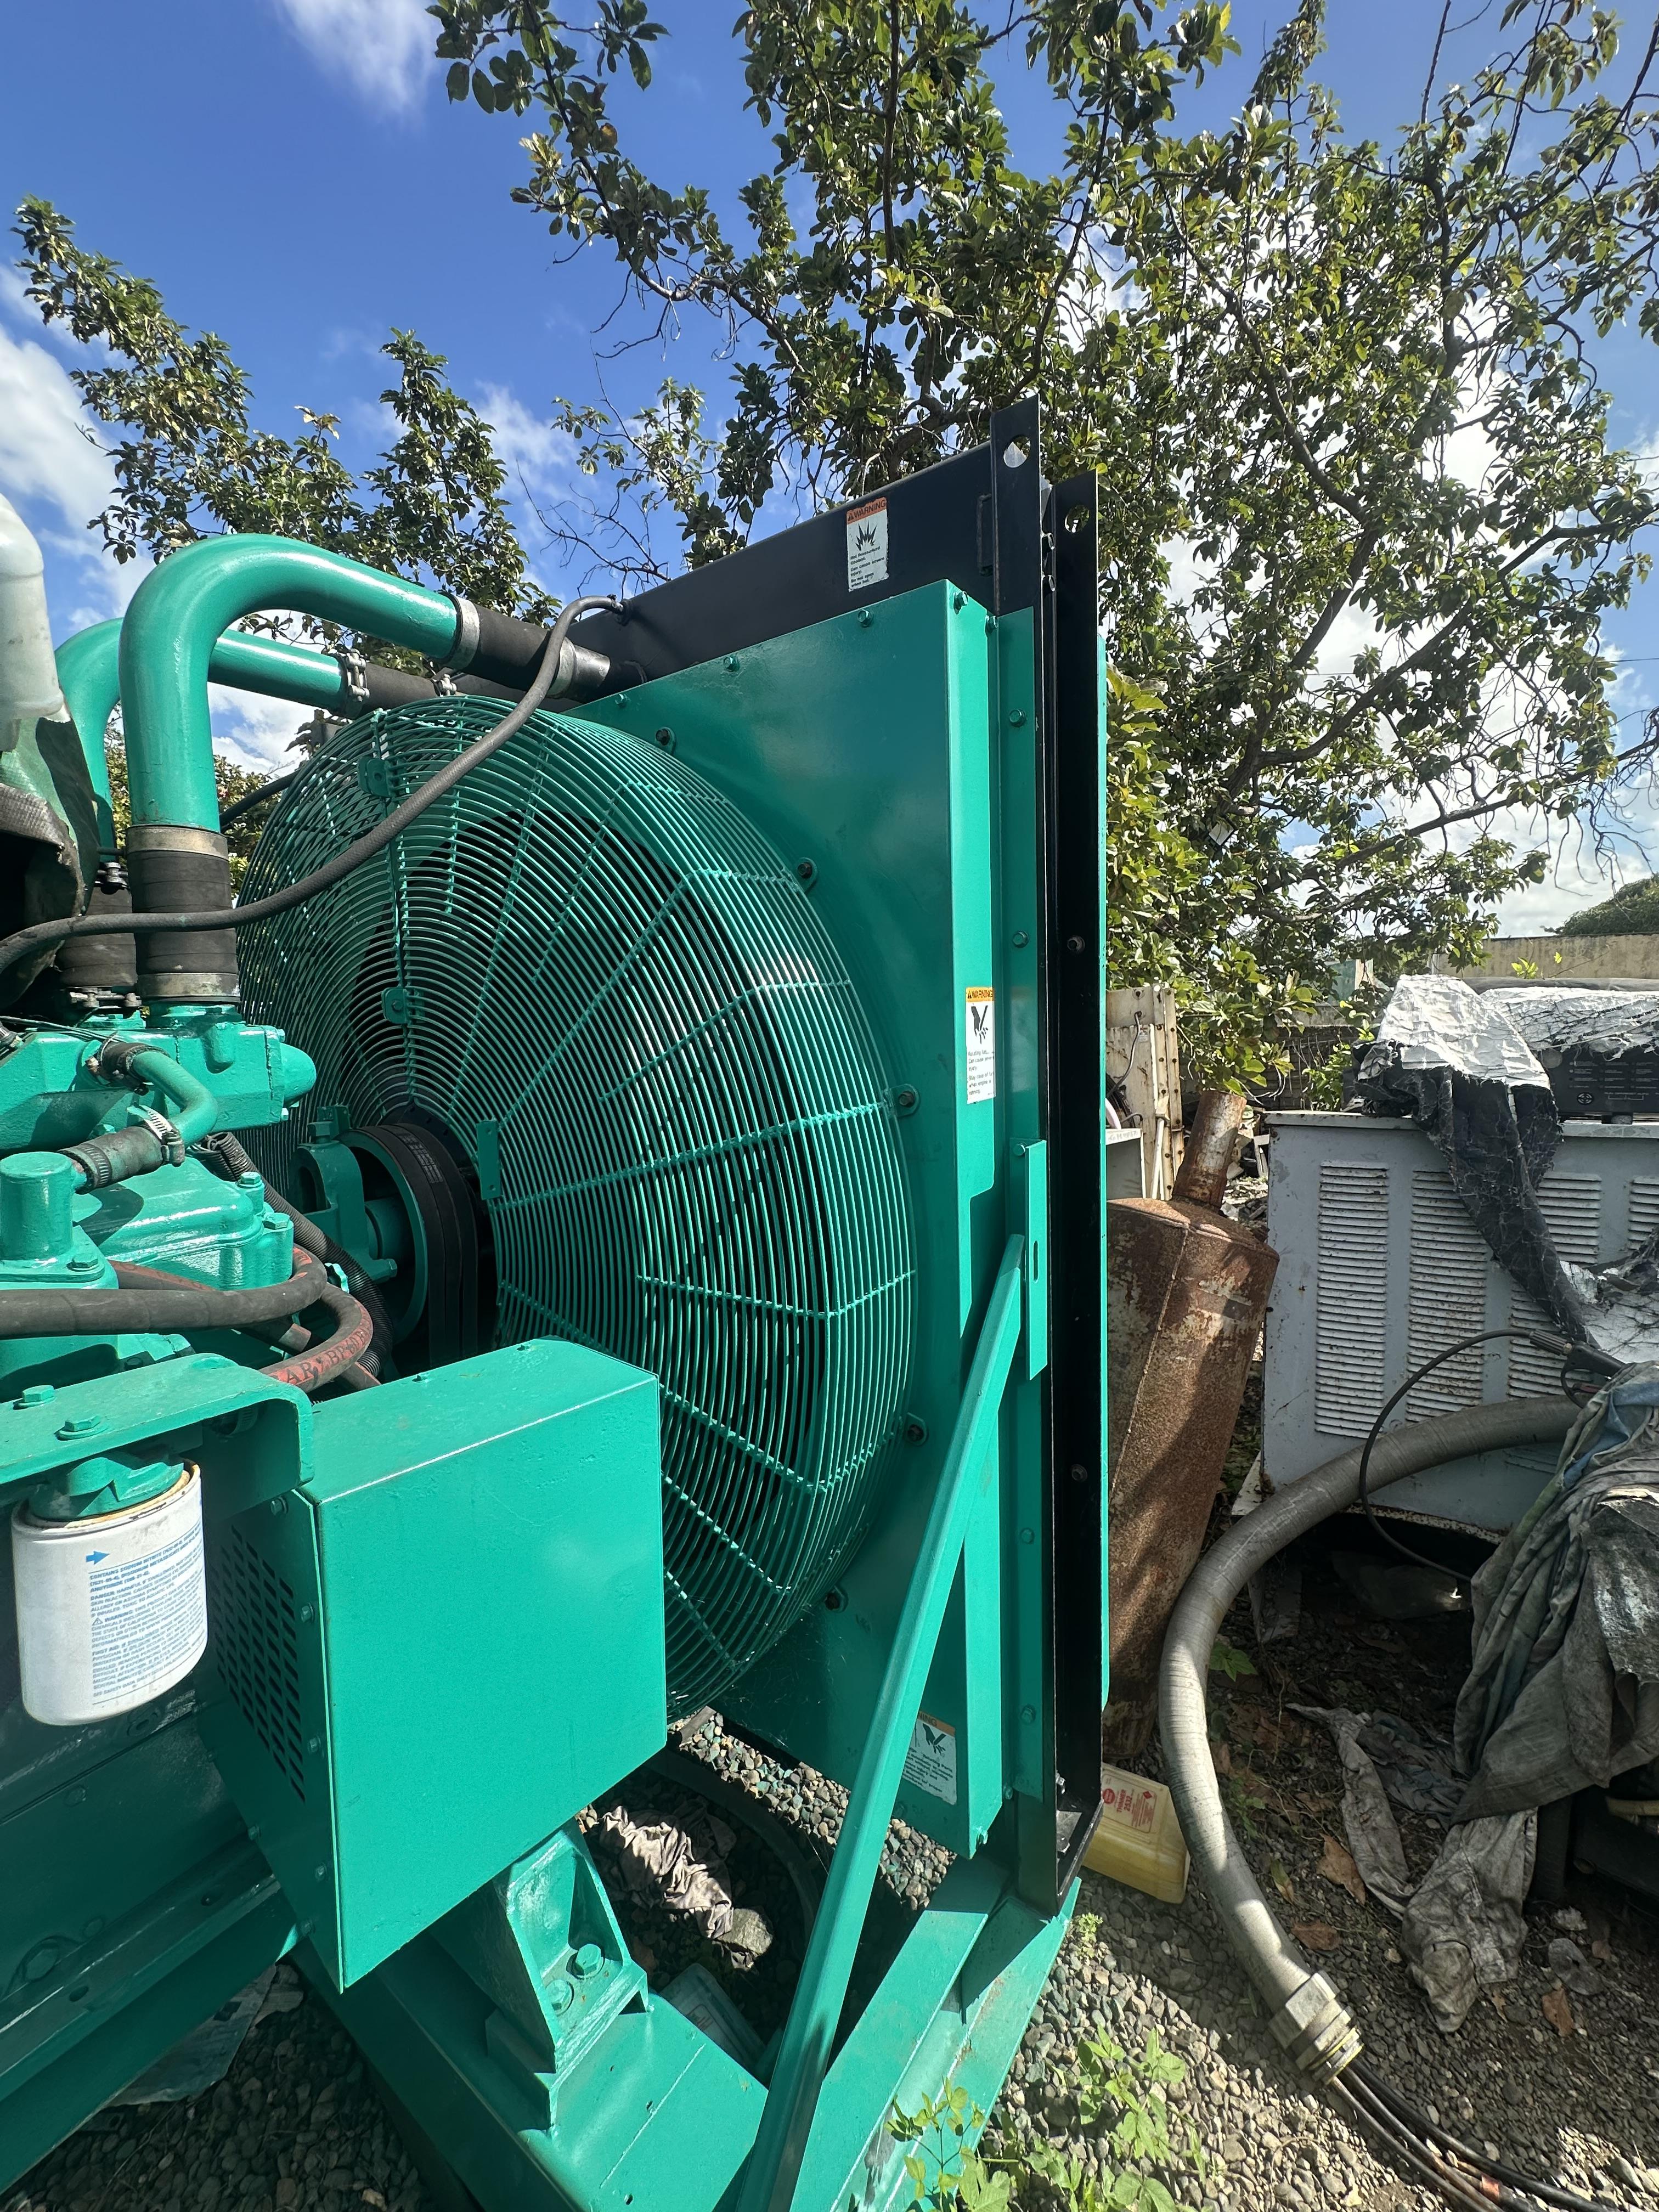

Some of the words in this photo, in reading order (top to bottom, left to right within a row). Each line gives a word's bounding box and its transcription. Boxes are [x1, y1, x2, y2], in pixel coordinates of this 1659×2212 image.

[854, 500, 886, 519] WARNING
[972, 989, 993, 998] WARNING
[89, 1569, 118, 1579] CONTAINS
[918, 1711, 937, 1726] NING
